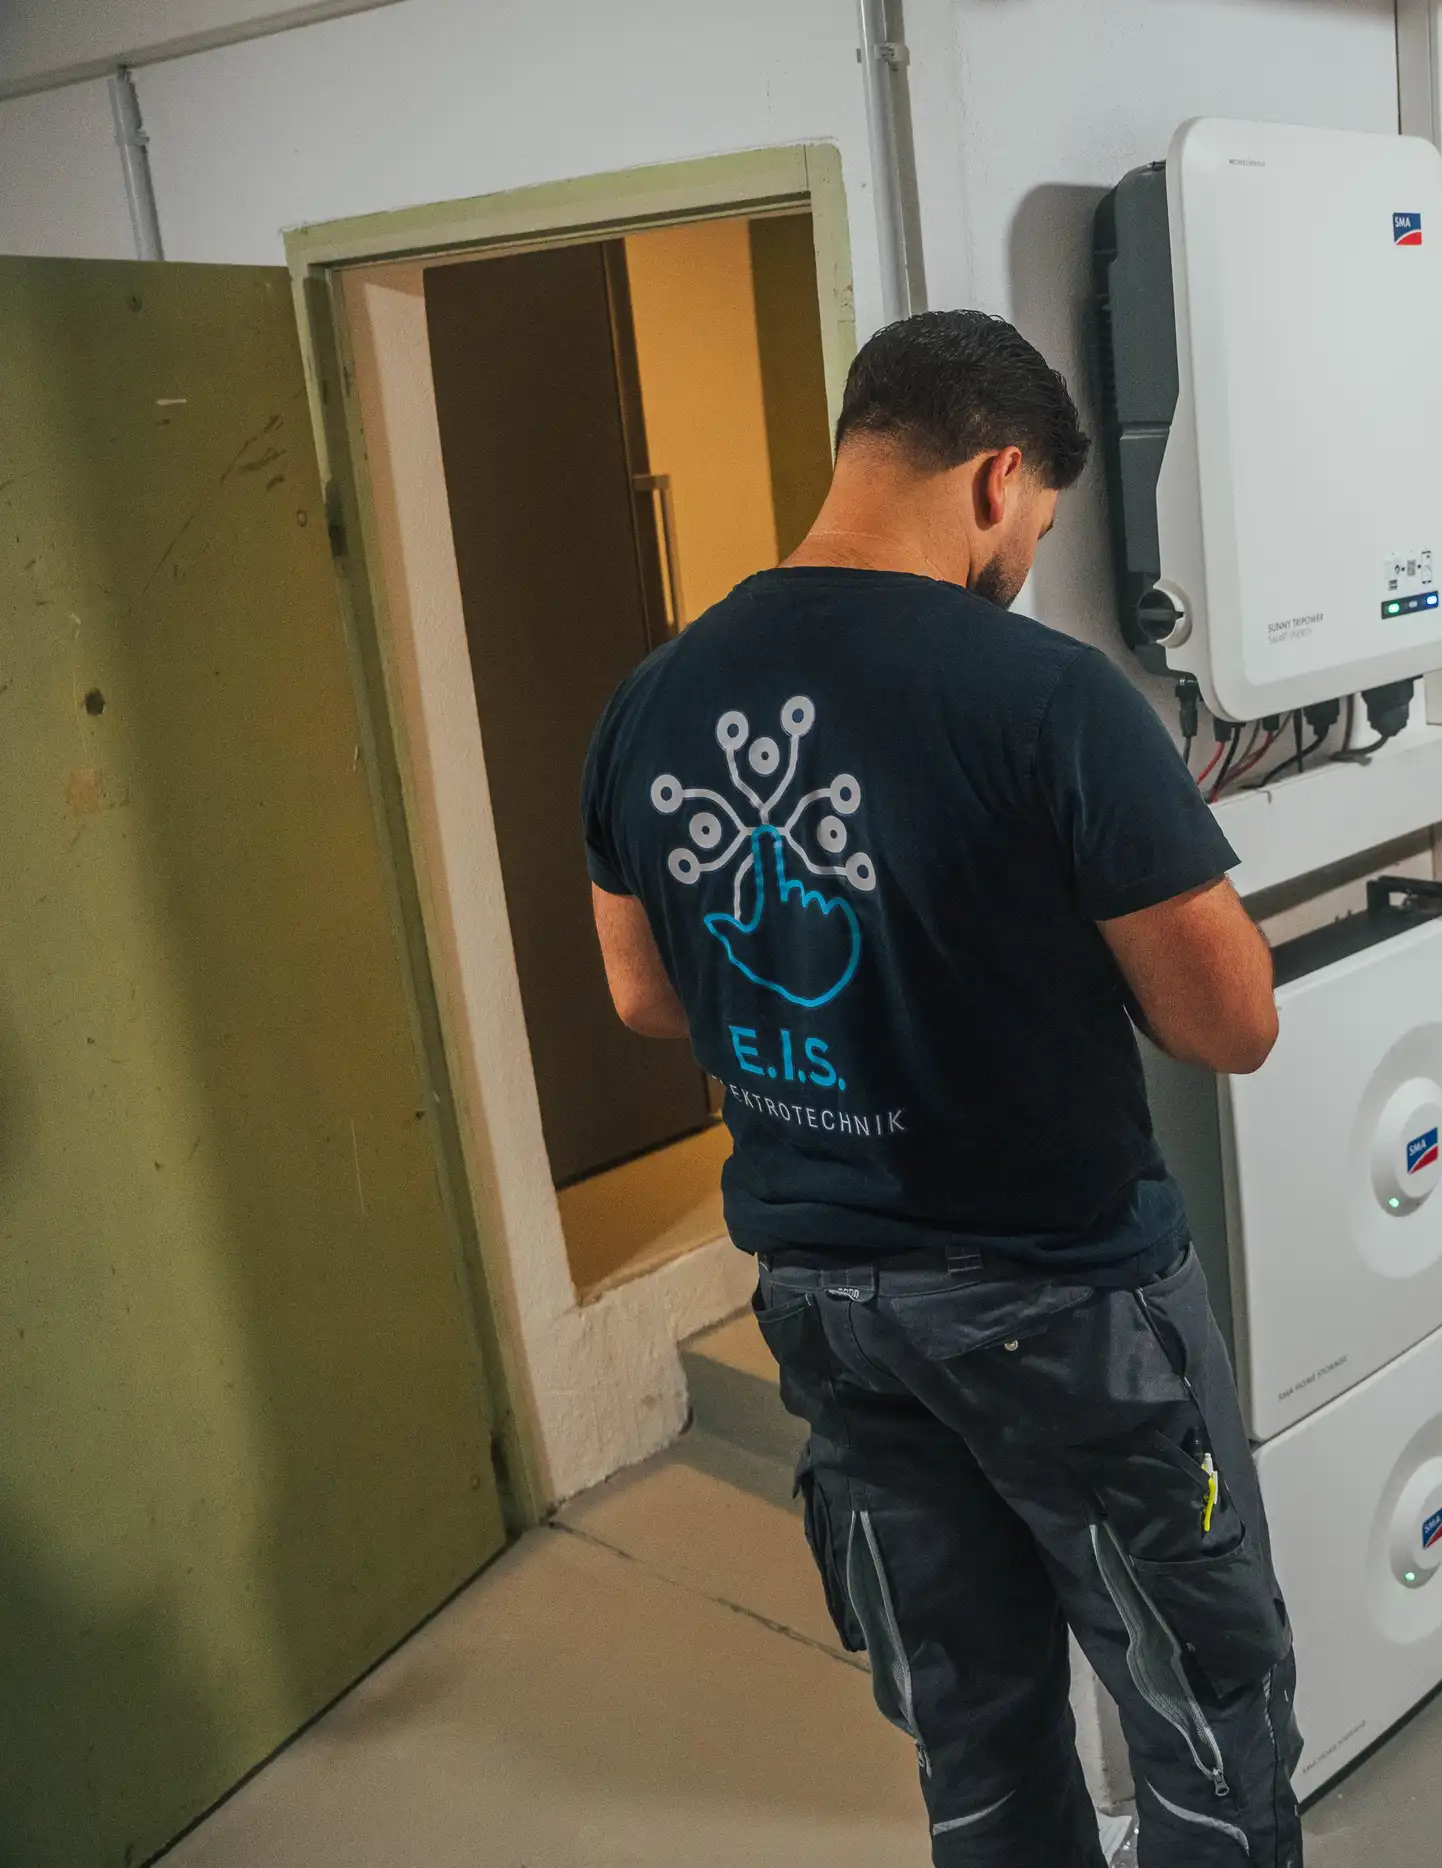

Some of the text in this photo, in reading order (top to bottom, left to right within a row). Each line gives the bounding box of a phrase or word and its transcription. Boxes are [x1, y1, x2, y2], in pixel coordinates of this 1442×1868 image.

[1395, 216, 1411, 228] SMA
[1267, 621, 1291, 633] SUNNY
[728, 1025, 846, 1091] E.I.S.
[711, 1074, 905, 1136] EKTROTECHNIK
[1409, 1139, 1426, 1156] SMA
